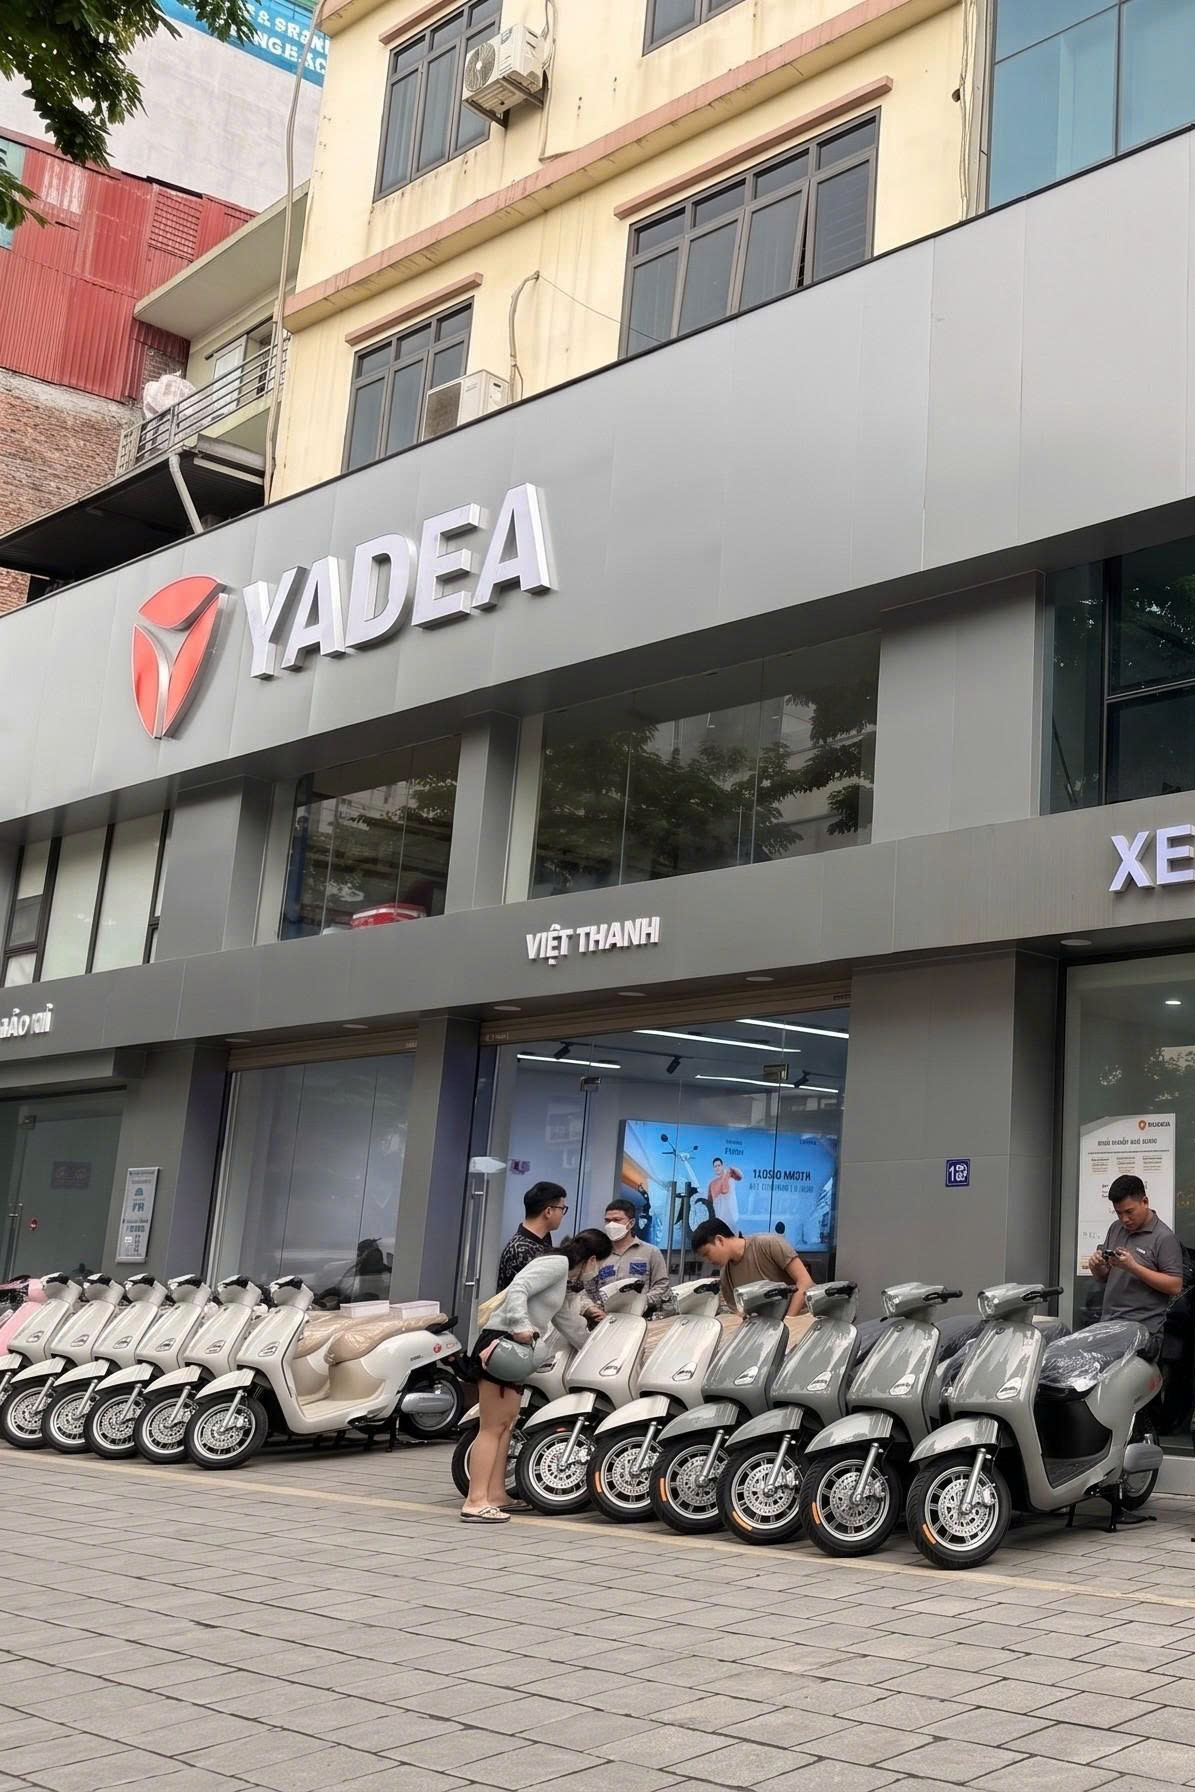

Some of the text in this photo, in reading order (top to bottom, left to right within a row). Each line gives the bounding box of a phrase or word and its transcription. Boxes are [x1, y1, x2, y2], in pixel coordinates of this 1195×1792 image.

[242, 482, 553, 680] YADEA
[526, 916, 661, 965] VIỆT THANH
